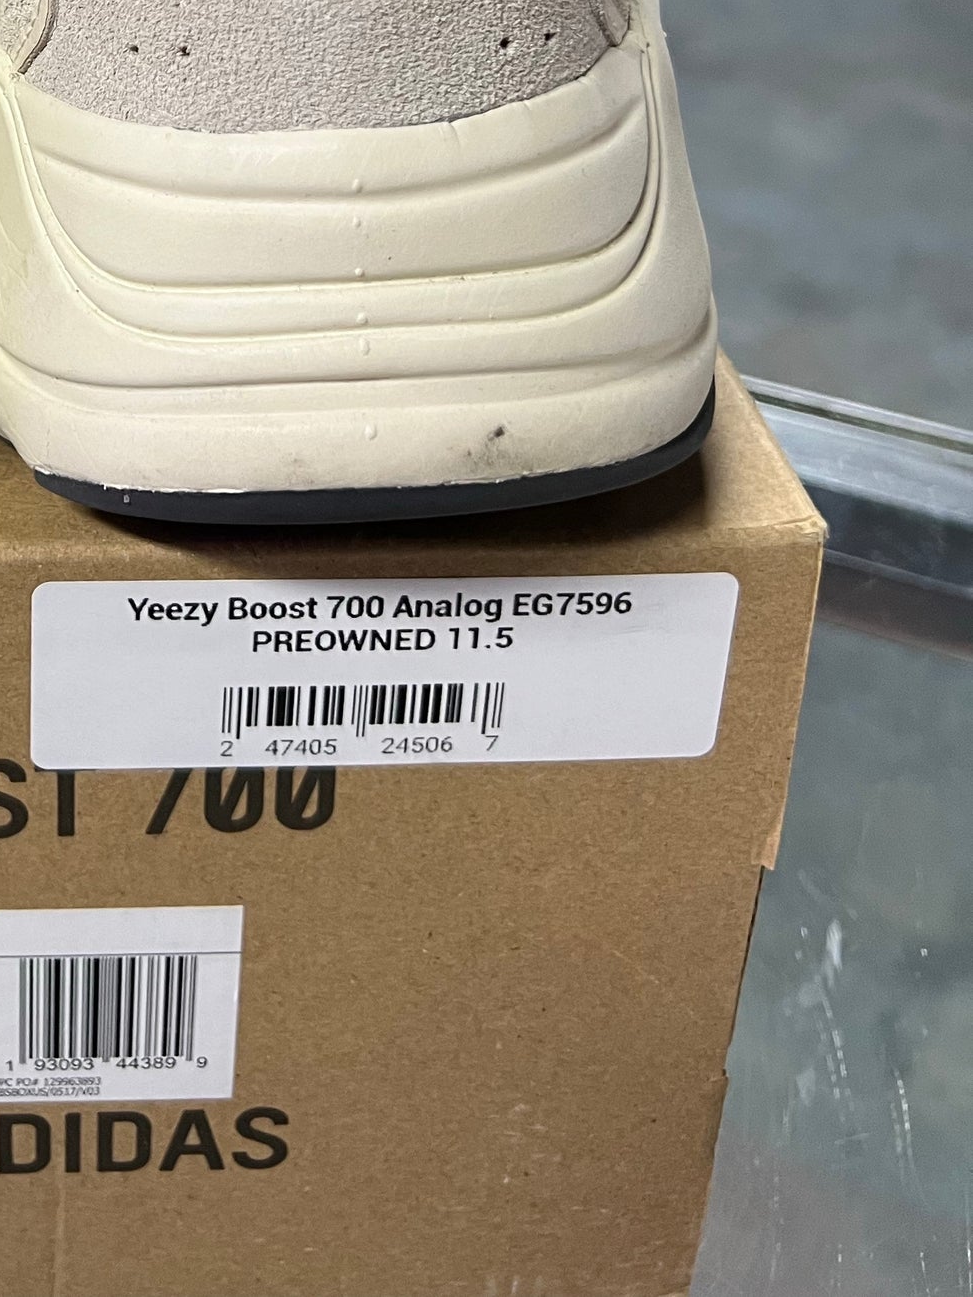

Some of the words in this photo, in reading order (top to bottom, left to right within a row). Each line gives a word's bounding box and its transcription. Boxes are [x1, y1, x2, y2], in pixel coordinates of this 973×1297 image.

[128, 597, 218, 627] Yeezy
[229, 596, 317, 621] Boost
[326, 595, 385, 619] 700
[393, 592, 502, 623] Analog
[512, 591, 632, 617] EG7596
[252, 628, 436, 653] PREOWNED
[448, 626, 514, 650] 11.5
[220, 740, 234, 757] 2
[265, 738, 337, 756] 47405
[381, 736, 453, 755] 24506
[486, 734, 499, 751] 7
[6, 1060, 14, 1072] 1
[34, 1057, 96, 1071] 93093
[115, 1056, 177, 1070] 44389
[196, 1056, 208, 1069] 9
